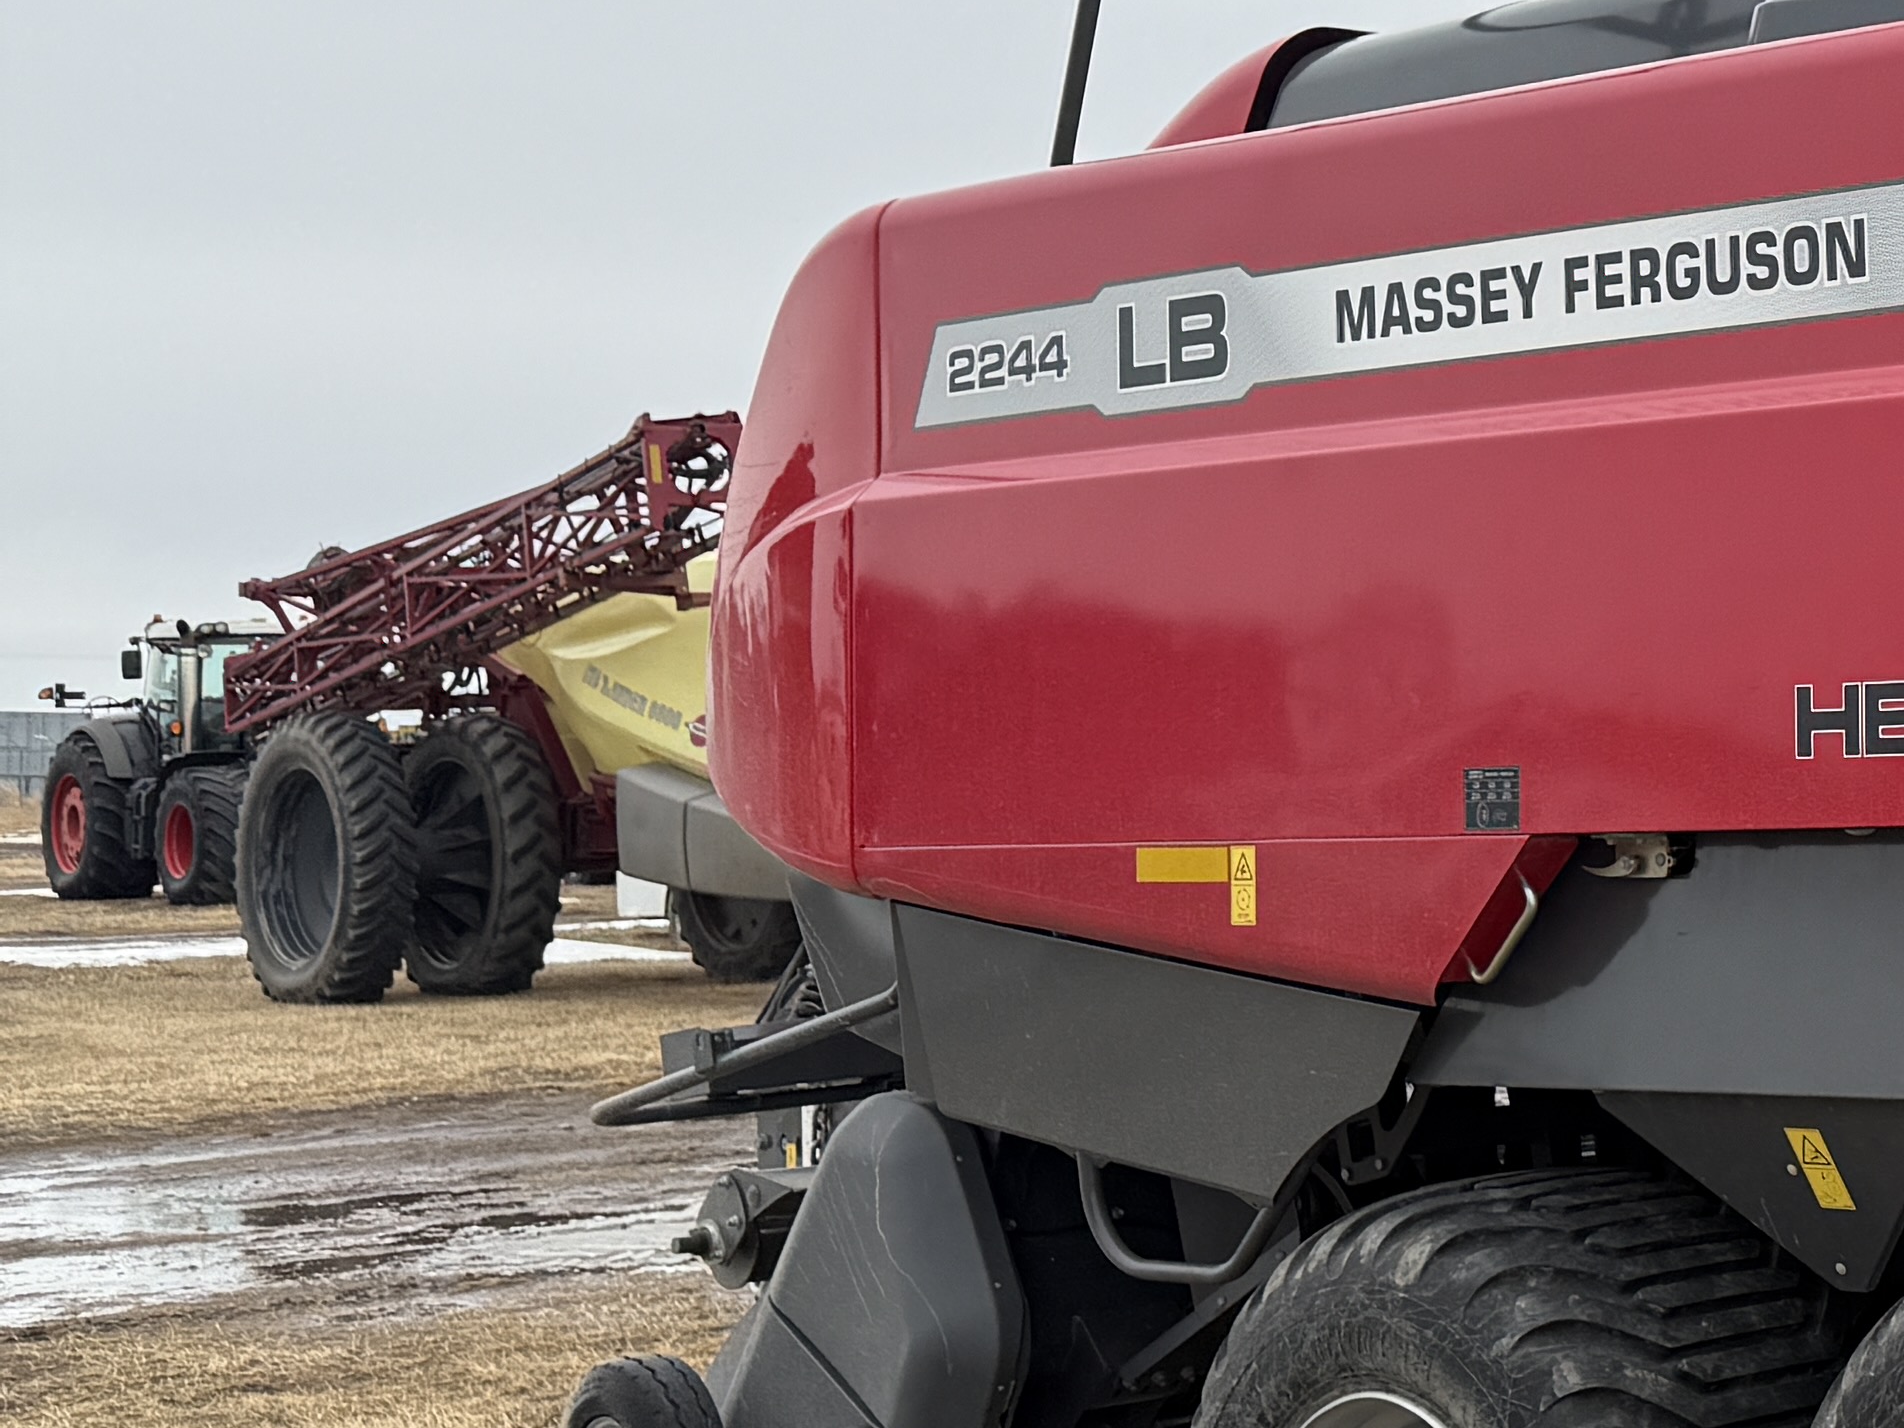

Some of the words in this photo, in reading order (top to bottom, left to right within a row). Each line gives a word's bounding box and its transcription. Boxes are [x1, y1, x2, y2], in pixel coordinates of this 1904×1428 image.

[1335, 260, 1543, 344] MASSEY
[1564, 216, 1868, 315] FERGUSON
[948, 332, 1069, 395] 2244
[1117, 291, 1231, 394] LB
